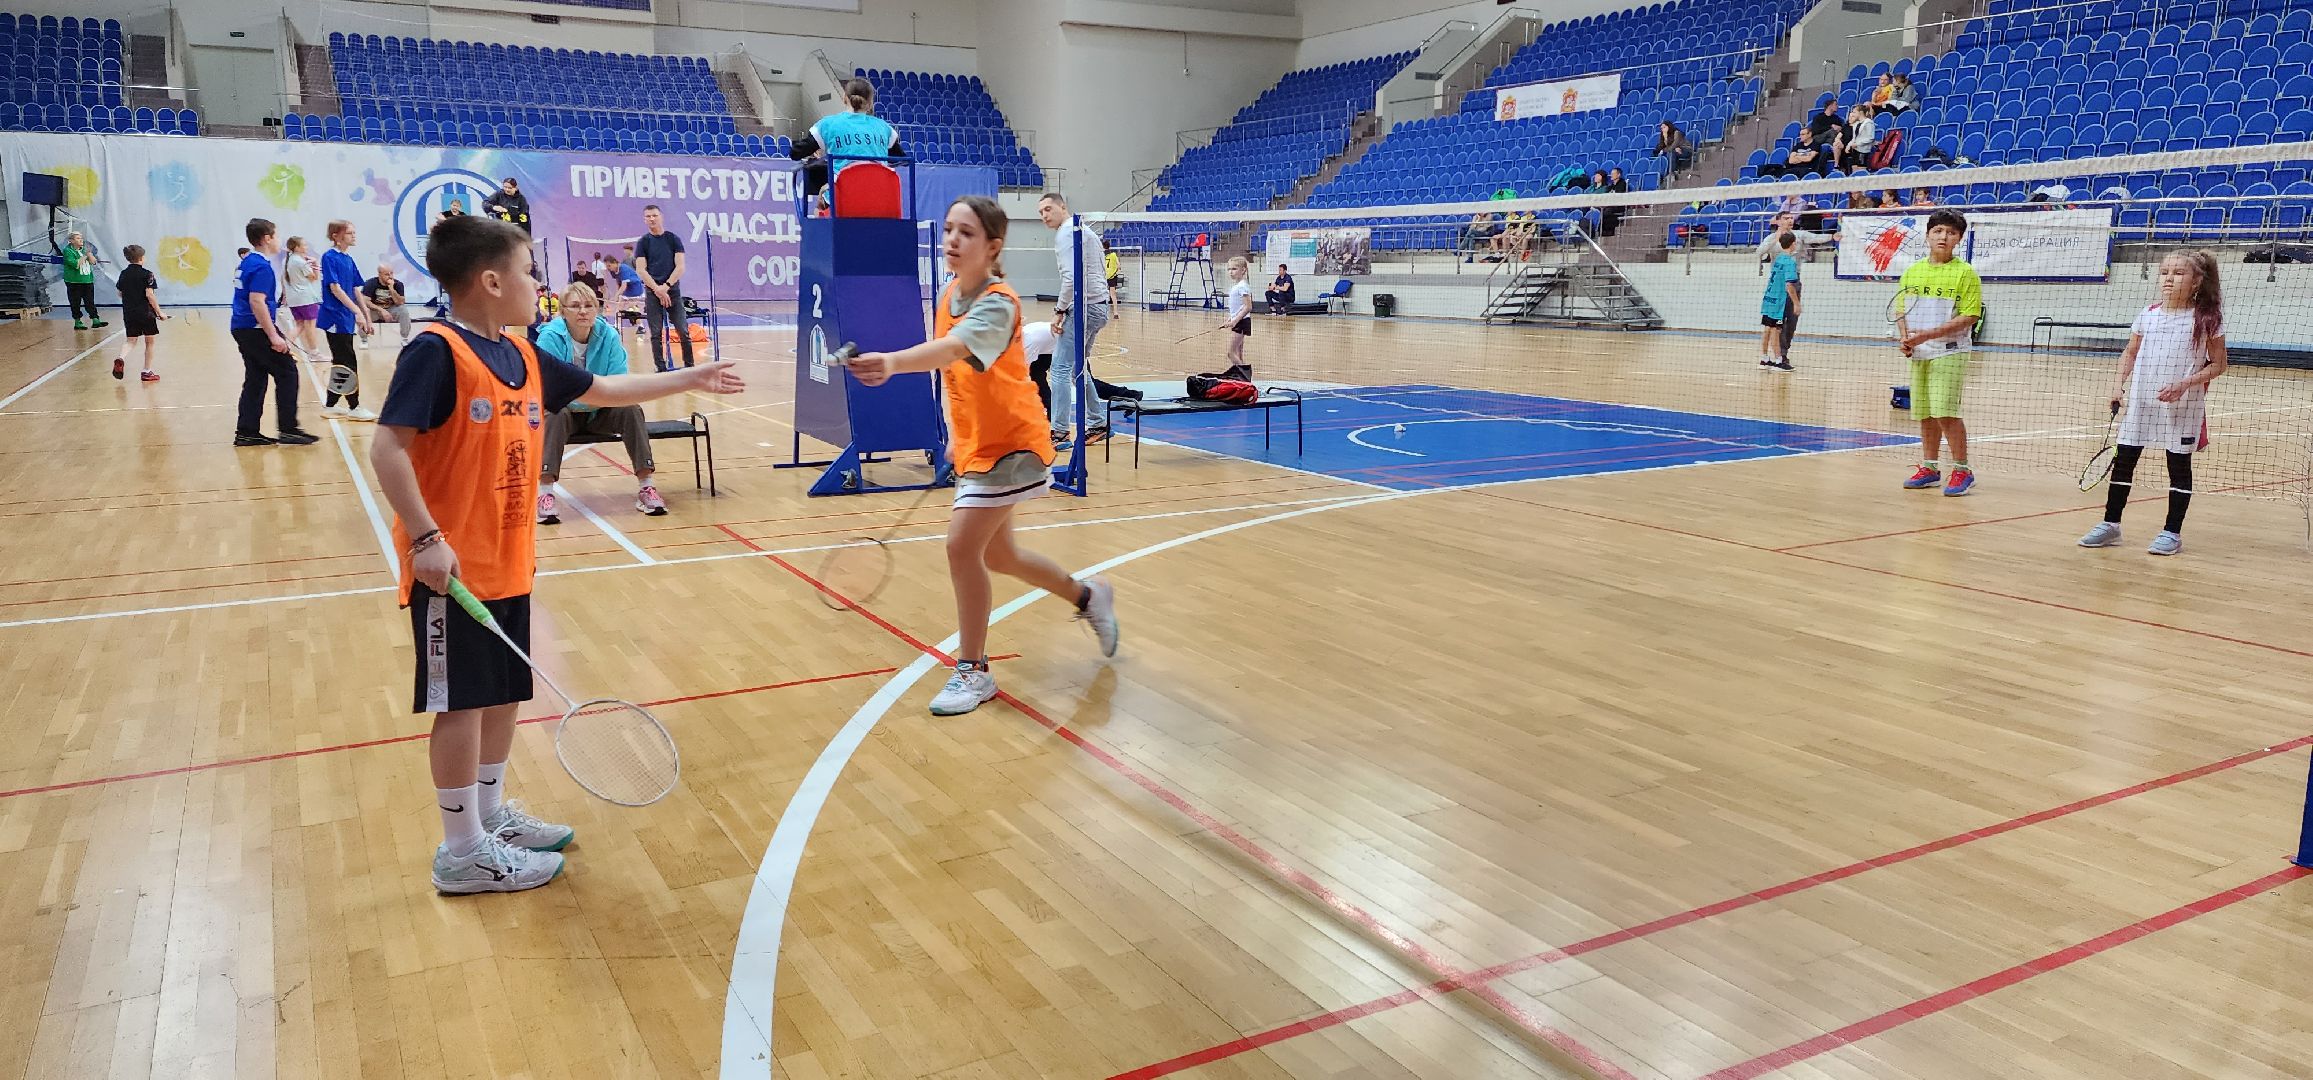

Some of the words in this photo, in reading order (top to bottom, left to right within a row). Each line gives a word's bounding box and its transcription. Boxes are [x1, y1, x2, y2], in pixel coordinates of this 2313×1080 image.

[836, 133, 885, 149] RUSSIA
[812, 283, 823, 319] 2
[430, 617, 445, 657] FILA
